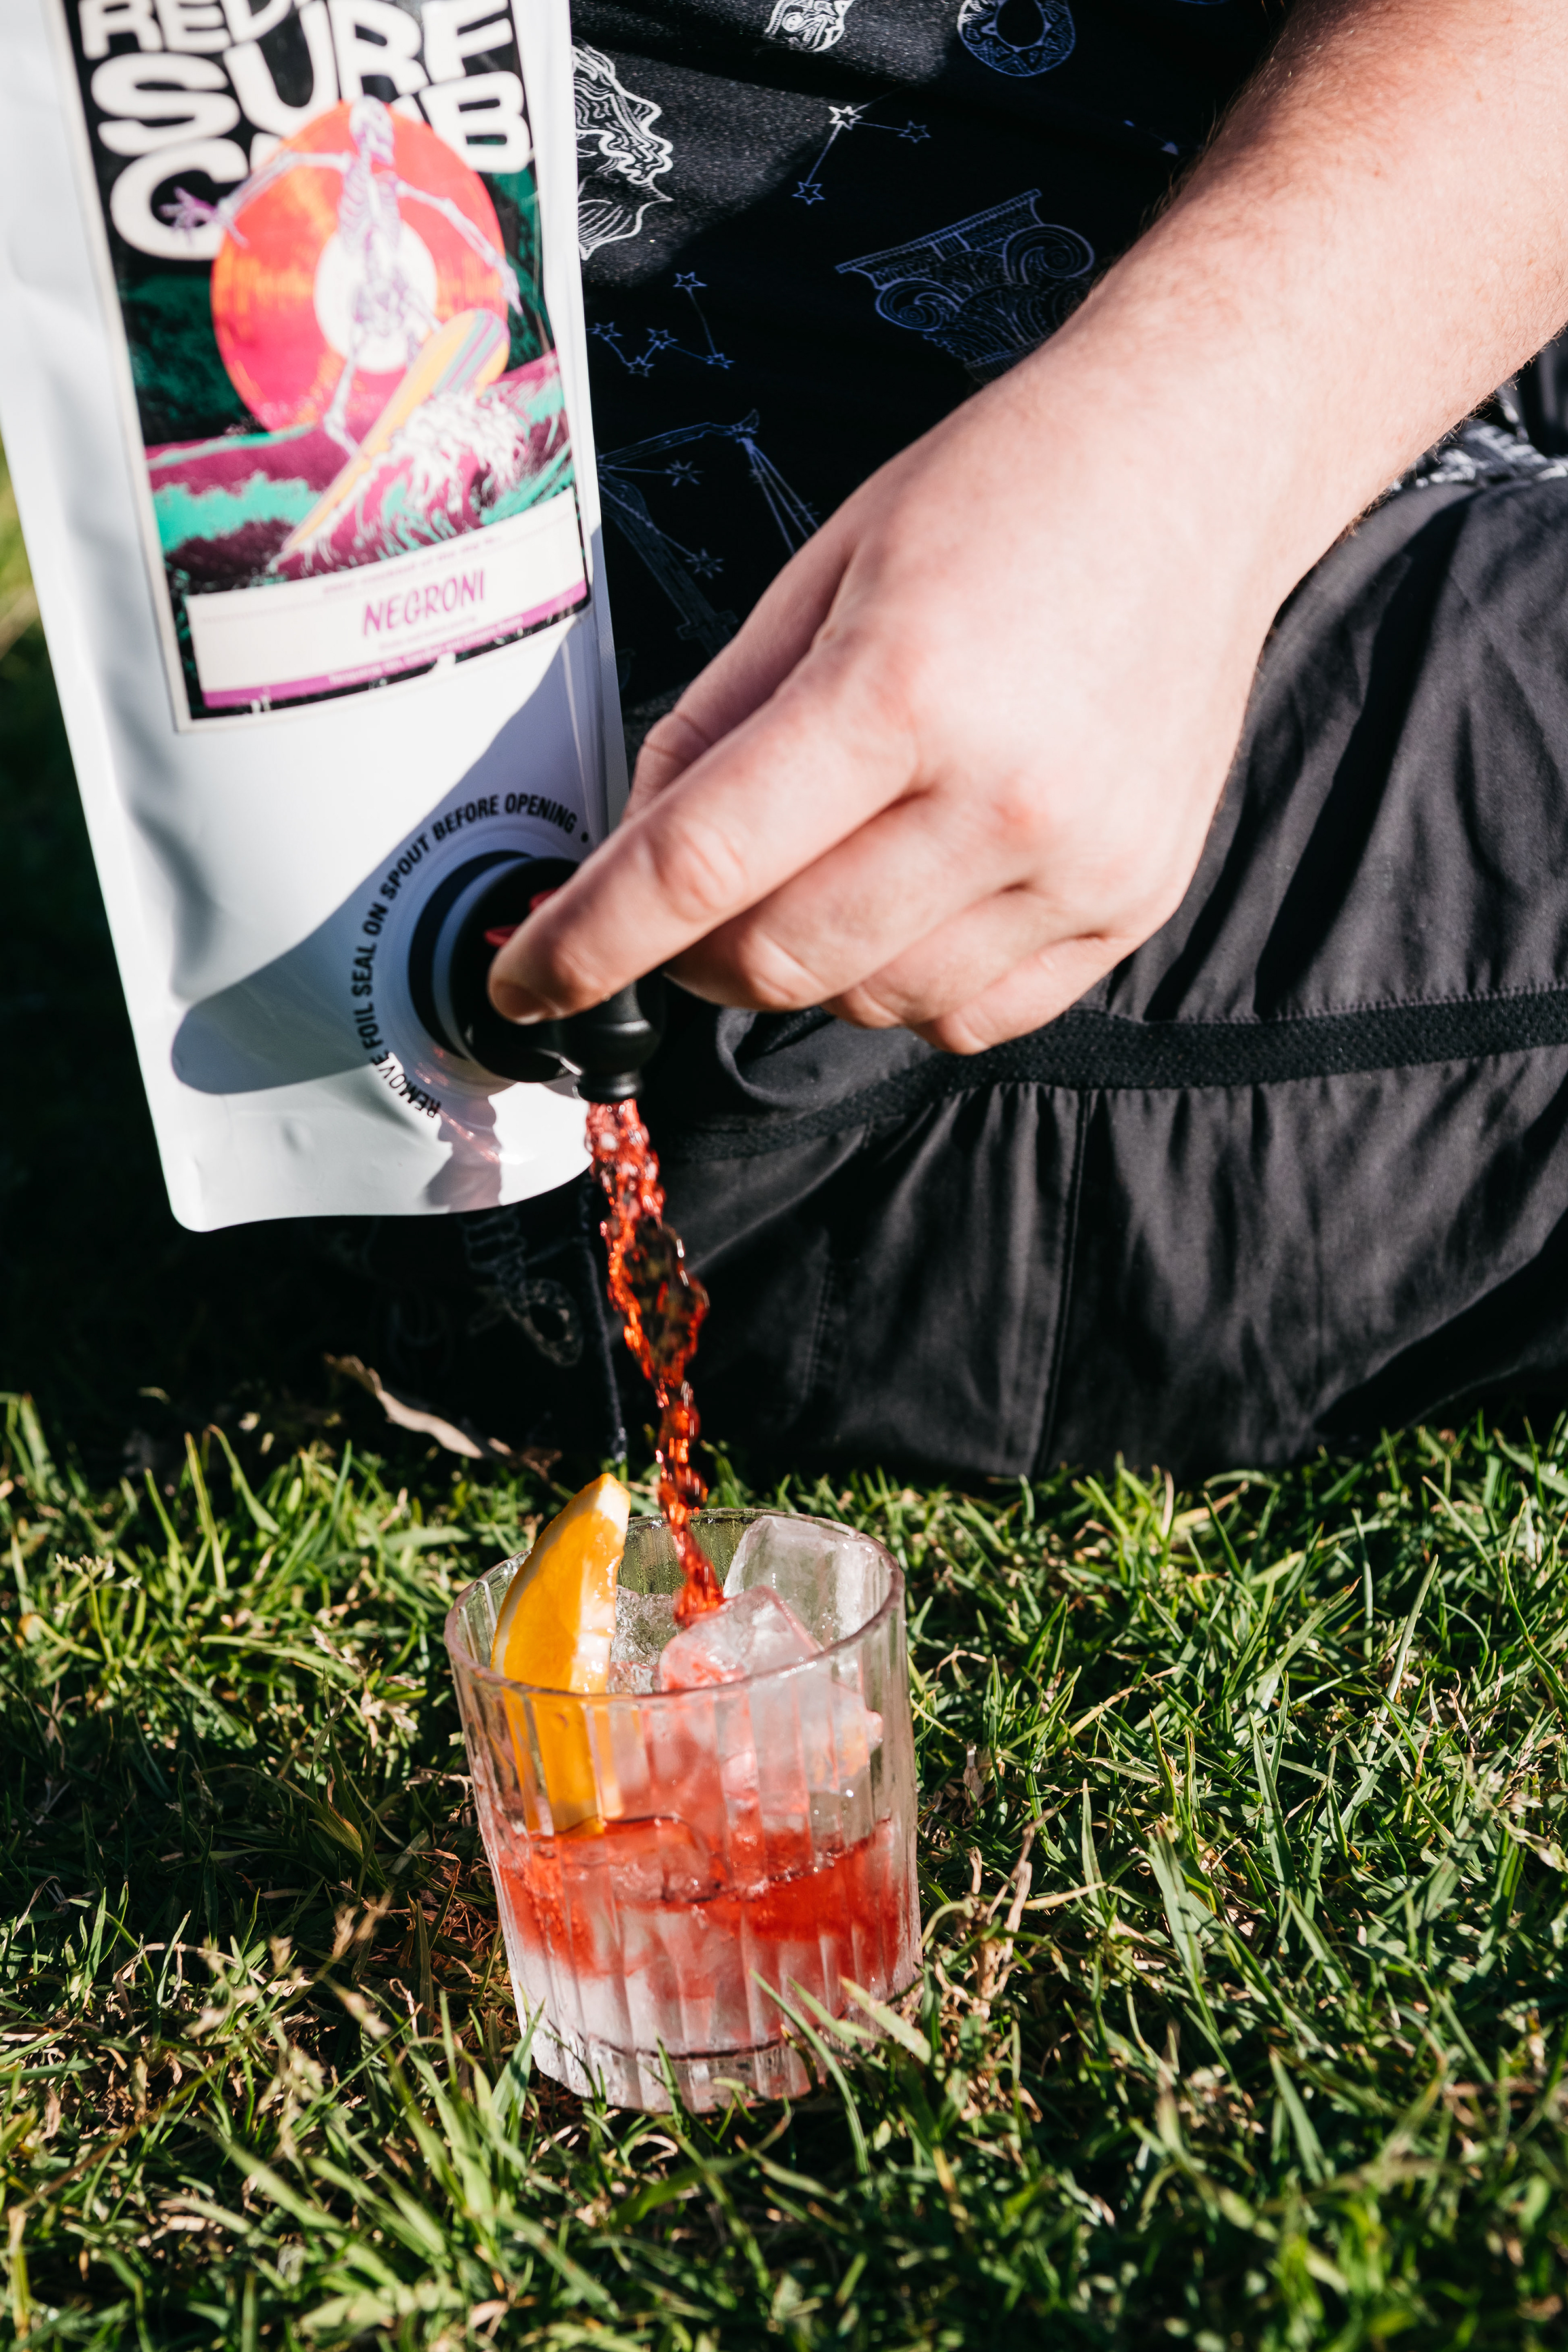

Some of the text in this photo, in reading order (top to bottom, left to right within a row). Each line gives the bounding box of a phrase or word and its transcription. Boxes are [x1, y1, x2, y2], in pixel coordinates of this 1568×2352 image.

[91, 0, 513, 156] SURF
[109, 70, 531, 260] CB
[363, 568, 485, 636] NEGRONI
[352, 792, 578, 1118] REMOVE FOIL SEAL ON SPOUT BEFORE OPENING
